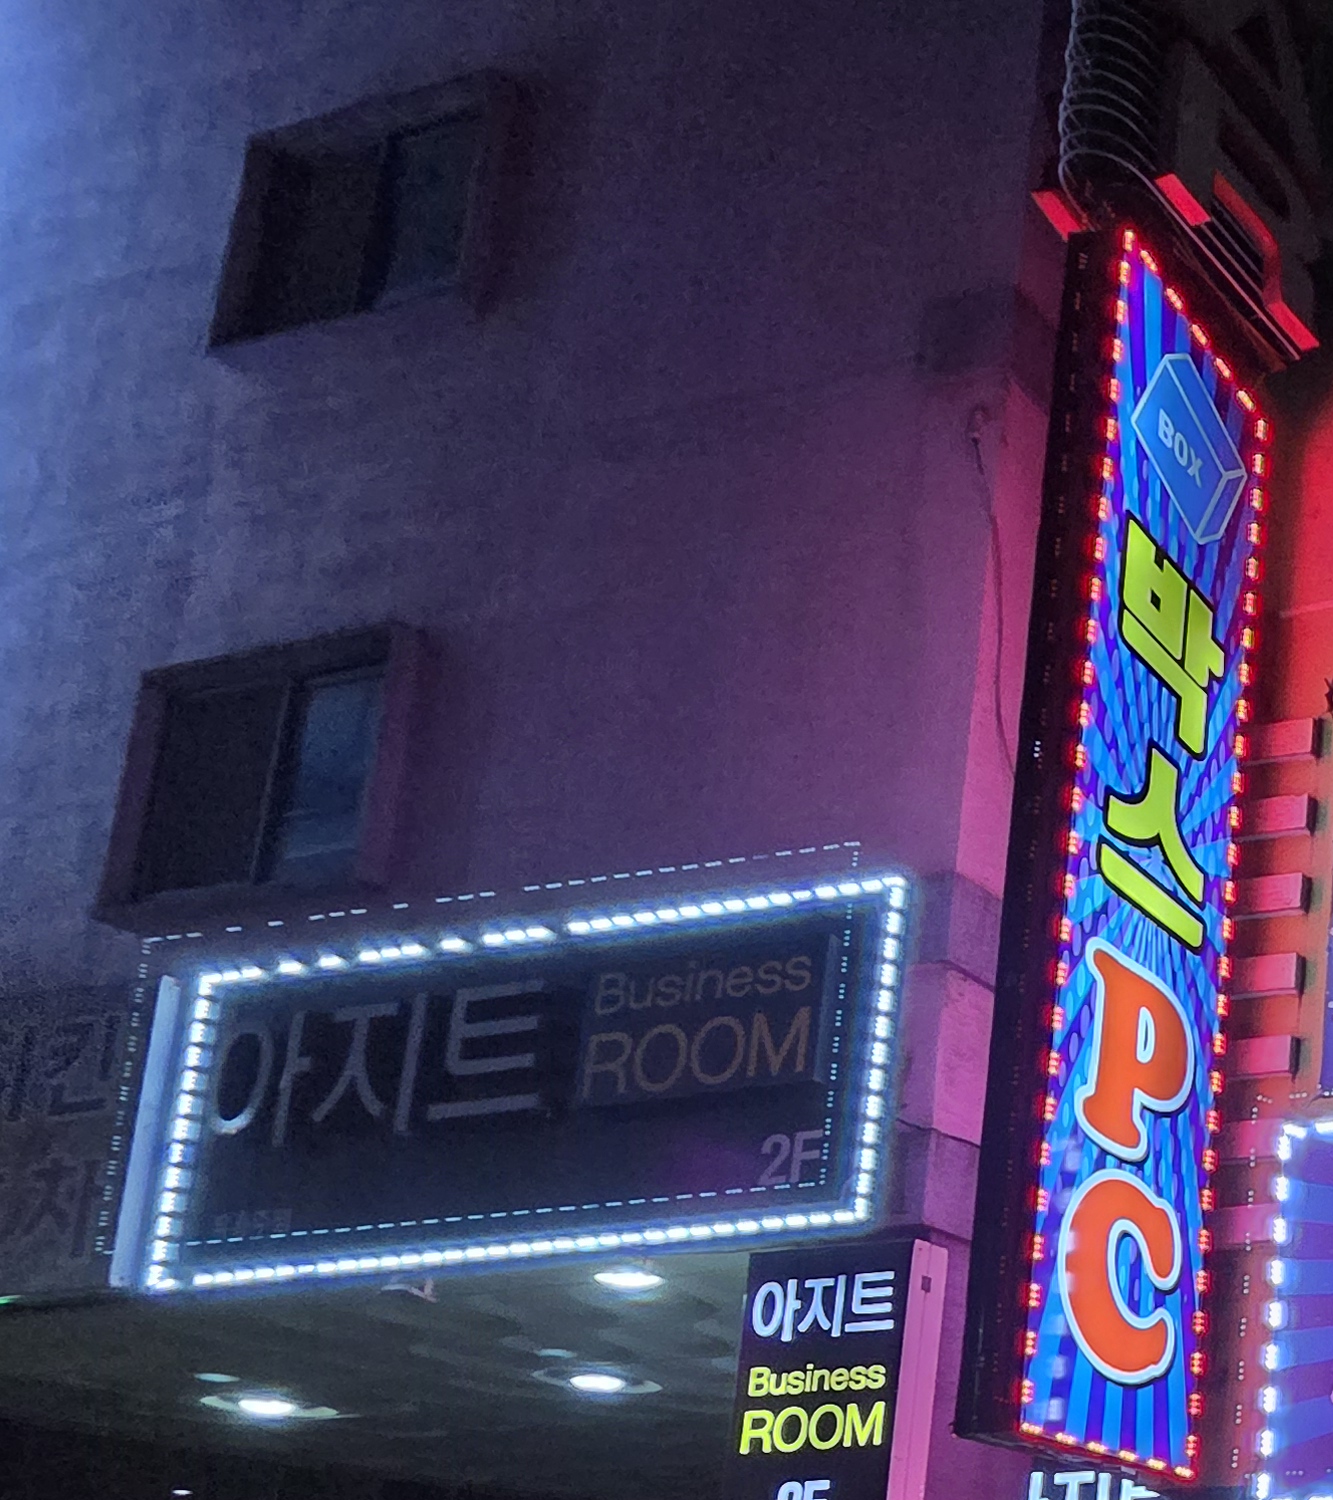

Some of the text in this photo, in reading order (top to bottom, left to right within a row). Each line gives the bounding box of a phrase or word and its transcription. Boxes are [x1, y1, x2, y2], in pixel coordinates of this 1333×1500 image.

[1158, 409, 1203, 489] BOX
[595, 950, 813, 1017] Business
[211, 978, 546, 1146] 아지트
[580, 1007, 811, 1101] ROOM
[759, 1132, 823, 1187] 2F
[751, 1271, 895, 1341] 아지트
[748, 1361, 886, 1398] Business
[738, 1401, 885, 1455] ROOM
